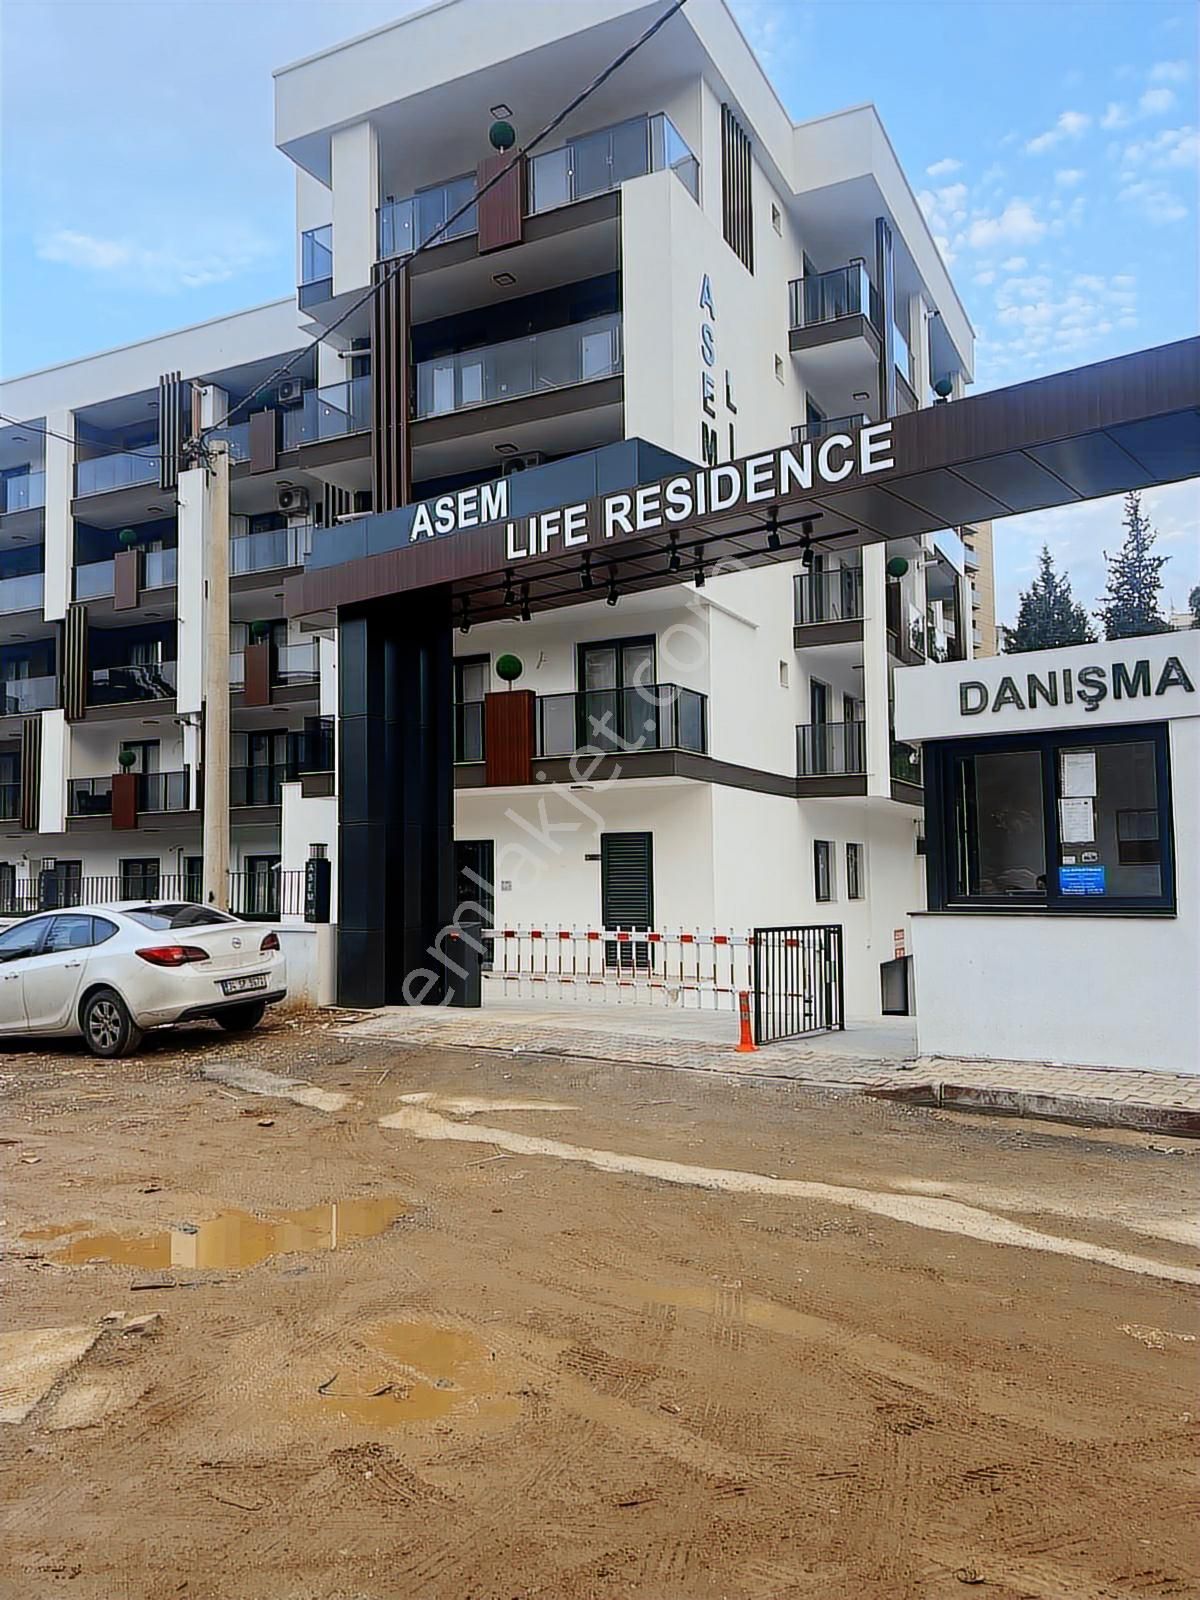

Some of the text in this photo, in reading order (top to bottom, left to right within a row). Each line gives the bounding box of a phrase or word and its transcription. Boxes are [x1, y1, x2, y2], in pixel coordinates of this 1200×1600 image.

[699, 273, 718, 466] ASEM
[724, 369, 738, 461] LI
[409, 479, 509, 542] ASEM
[506, 421, 896, 561] LIFE RESIDENCE
[959, 656, 1195, 716] DANIŞMA
